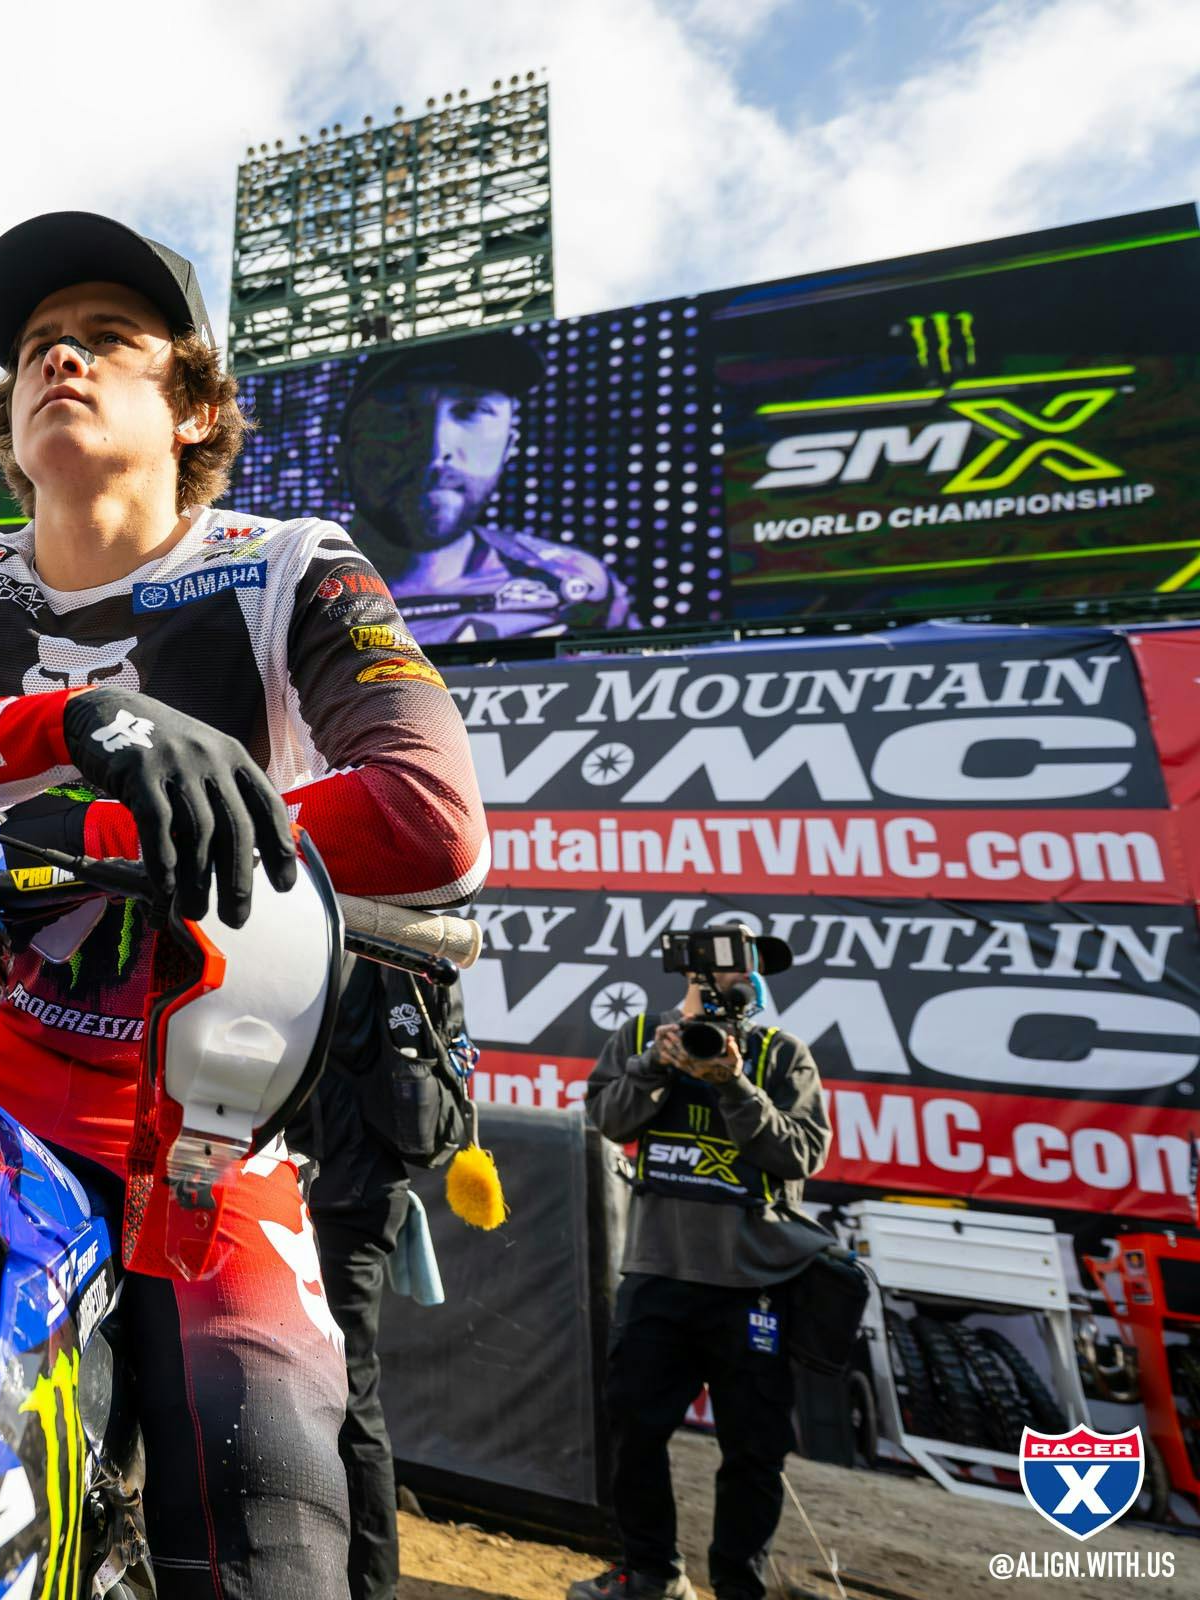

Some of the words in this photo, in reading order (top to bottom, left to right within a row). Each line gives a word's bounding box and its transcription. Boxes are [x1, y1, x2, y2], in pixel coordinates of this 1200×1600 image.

[752, 388, 1126, 494] SMX
[753, 510, 881, 542] WORLD
[888, 483, 1154, 528] CHAMPIONSHIP
[170, 565, 260, 603] YAMAHA
[576, 656, 1120, 723] MOUNTAIN
[492, 817, 1165, 882] ntainATVMC.com
[648, 1141, 741, 1184] SMX
